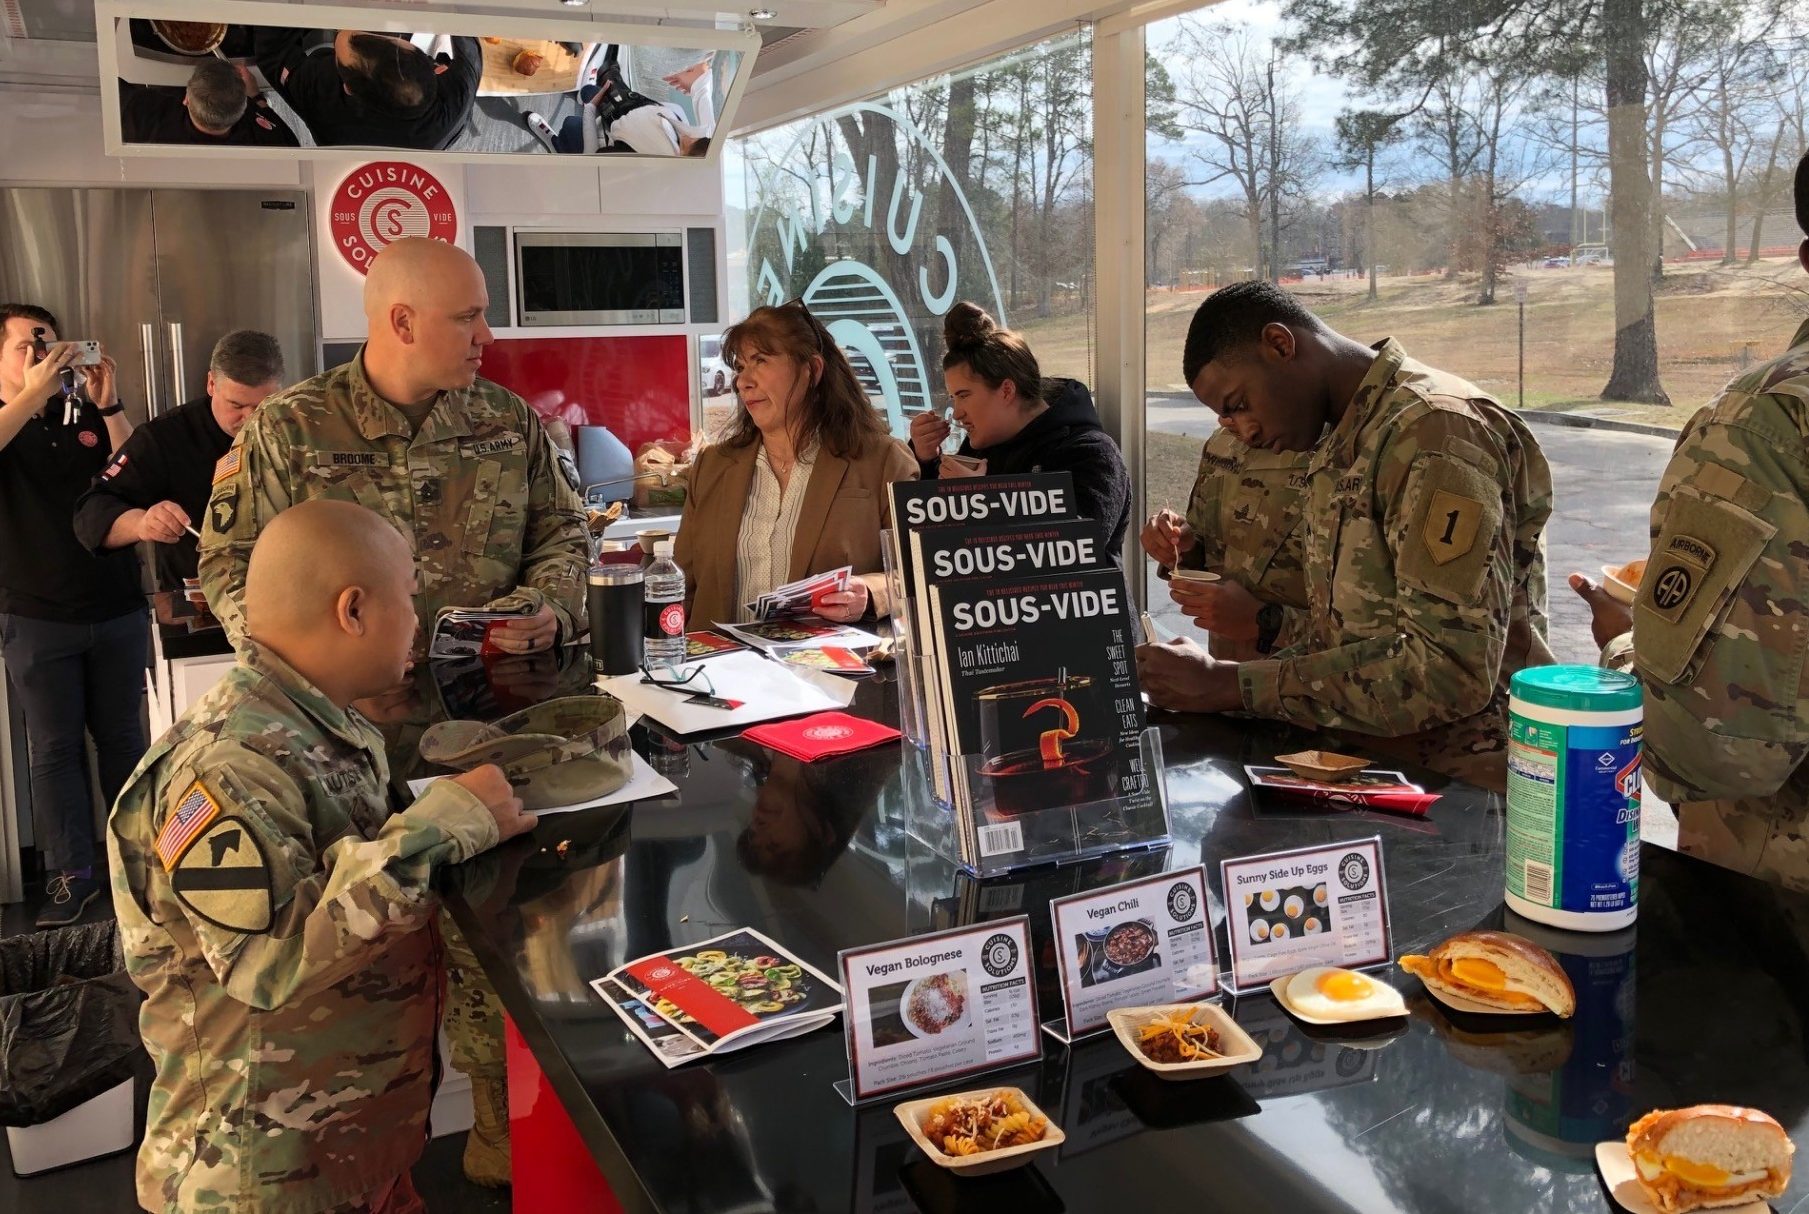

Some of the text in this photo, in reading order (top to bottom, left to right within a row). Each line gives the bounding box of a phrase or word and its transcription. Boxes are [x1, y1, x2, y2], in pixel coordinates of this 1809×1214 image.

[347, 167, 439, 200] CUISINE
[334, 212, 356, 222] SOUS
[433, 213, 452, 222] VIDE
[332, 453, 376, 465] BROOME
[907, 488, 1067, 525] SOUS-VIDE
[1439, 509, 1459, 544] 1
[934, 538, 1097, 578] SOUS-VIDE
[1669, 538, 1712, 563] AIRBORNE
[953, 588, 1120, 631] SOUS-VIDE
[1112, 629, 1124, 643] THE
[957, 640, 1020, 668] Ian Kittichai
[1106, 644, 1126, 661] SWEET
[1113, 660, 1128, 676] SPOT
[1114, 697, 1135, 714] CLEAN
[1122, 713, 1138, 729] EATS
[1236, 863, 1328, 885] Sunny Side Up Eggs
[1086, 898, 1139, 920] Vegan Chili
[985, 934, 1013, 951] CUISINE
[866, 948, 963, 977] Vegan Bolognese
[984, 956, 1017, 977] SOLUTIONS
[981, 979, 1025, 993] NUTRITION FACTS
